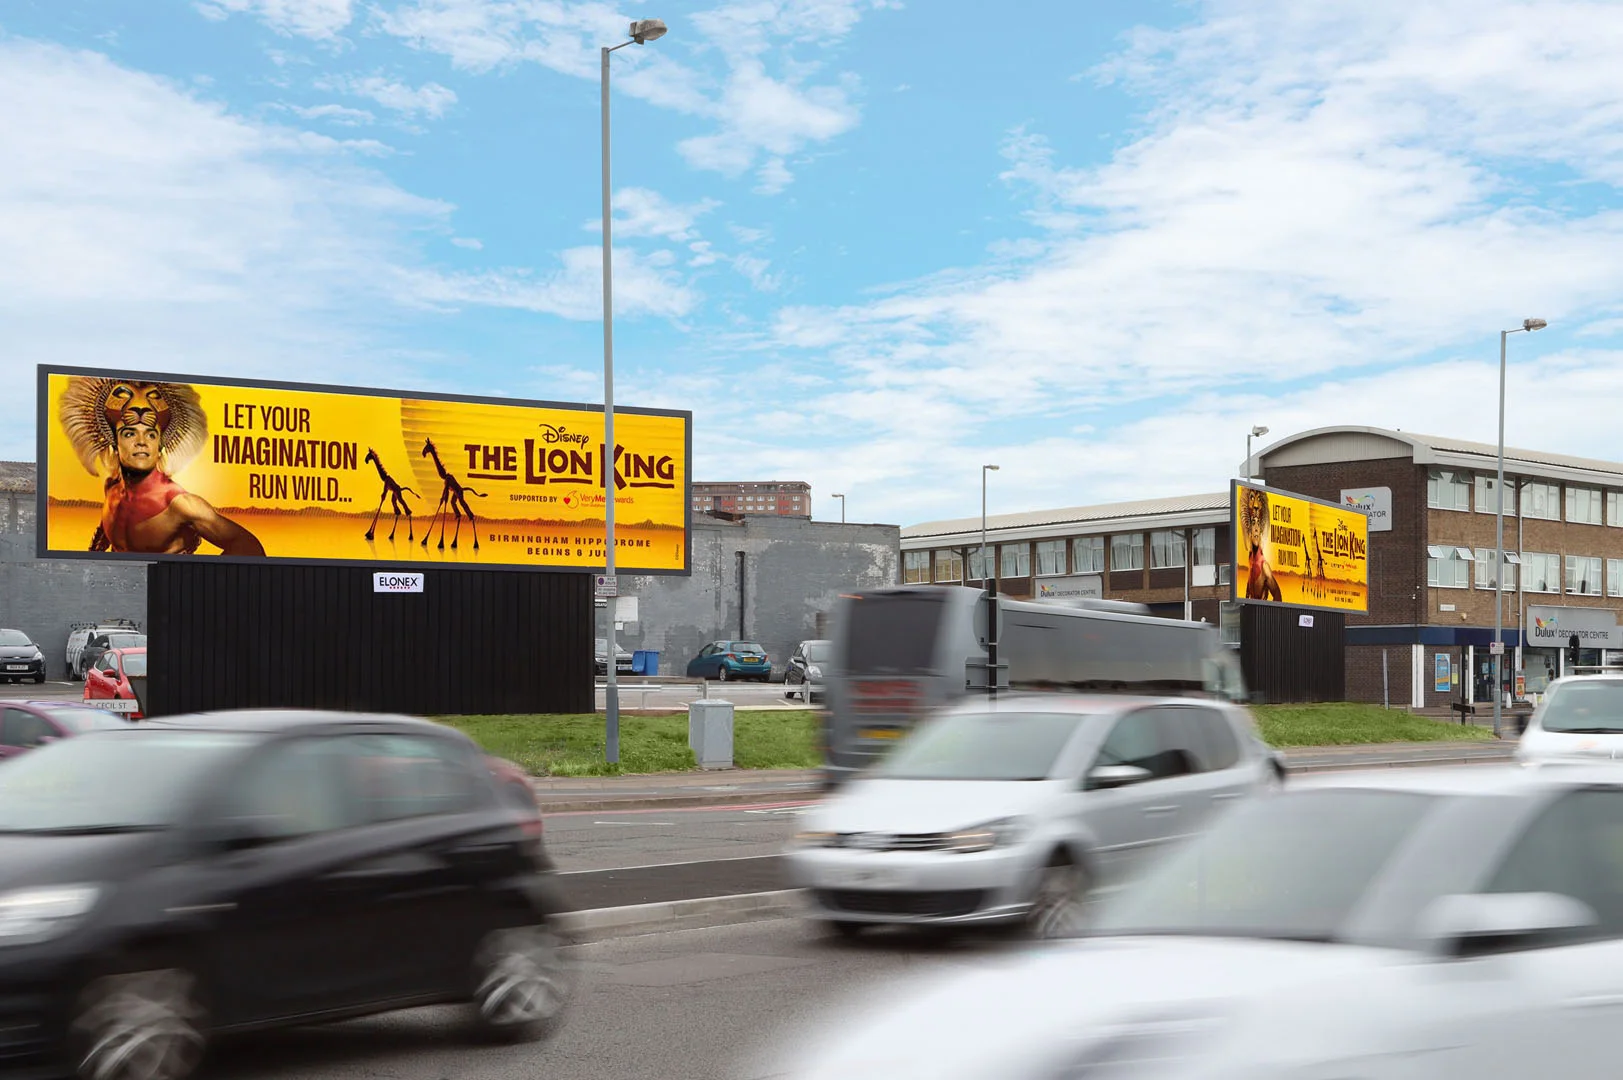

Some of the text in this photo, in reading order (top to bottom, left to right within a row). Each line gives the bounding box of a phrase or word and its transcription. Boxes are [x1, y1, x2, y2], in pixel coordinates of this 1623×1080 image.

[224, 403, 311, 433] LET YOUR
[213, 434, 358, 470] IMAGINATION
[464, 438, 674, 491] THE LION KING
[249, 473, 352, 503] RUN WILD...
[510, 494, 558, 503] SUPPORTED BY
[489, 534, 569, 544] BIRMINGHAM
[1321, 527, 1366, 560] THE LION KING
[527, 547, 571, 556] BEGINS
[588, 549, 607, 558] JUL
[379, 576, 418, 587] ELONEX
[1535, 626, 1555, 638] Dulux
[1590, 631, 1609, 640] CENTRE
